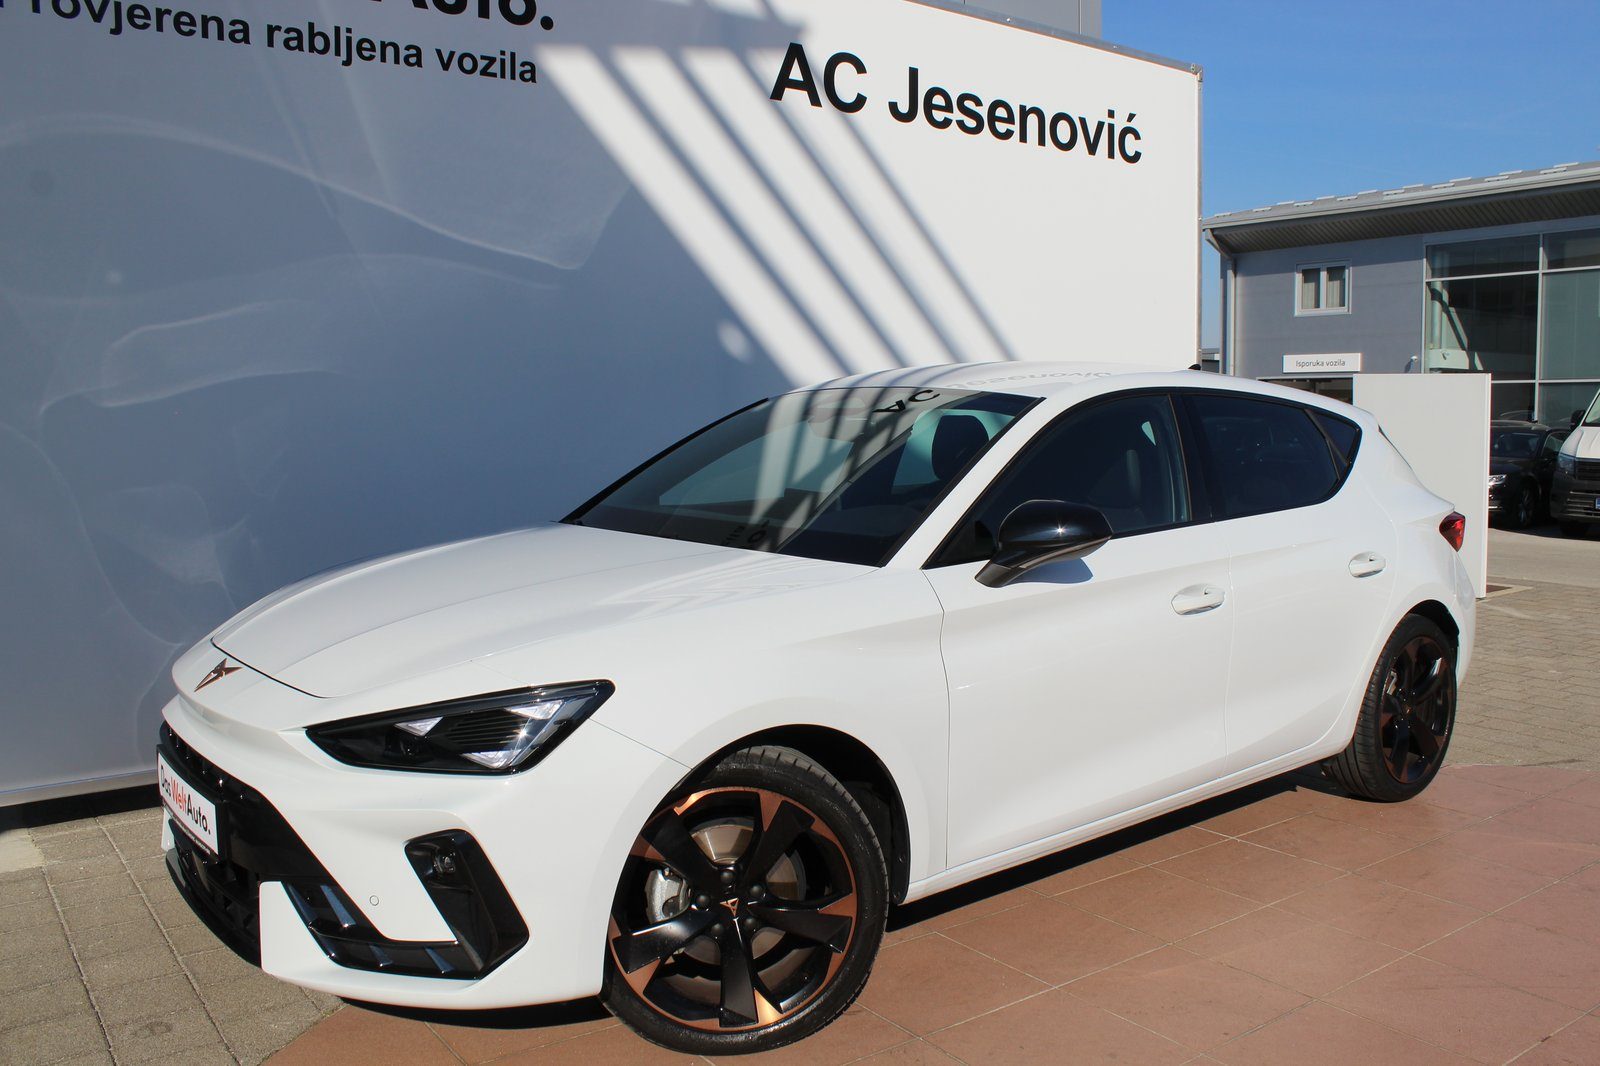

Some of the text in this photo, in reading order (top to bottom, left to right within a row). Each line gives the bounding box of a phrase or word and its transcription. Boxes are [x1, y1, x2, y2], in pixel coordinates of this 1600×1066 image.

[0, 0, 537, 84] ovjerena rabljena vozila
[769, 41, 1142, 164] AC Jesenović
[1295, 358, 1346, 368] Isporuka vozila
